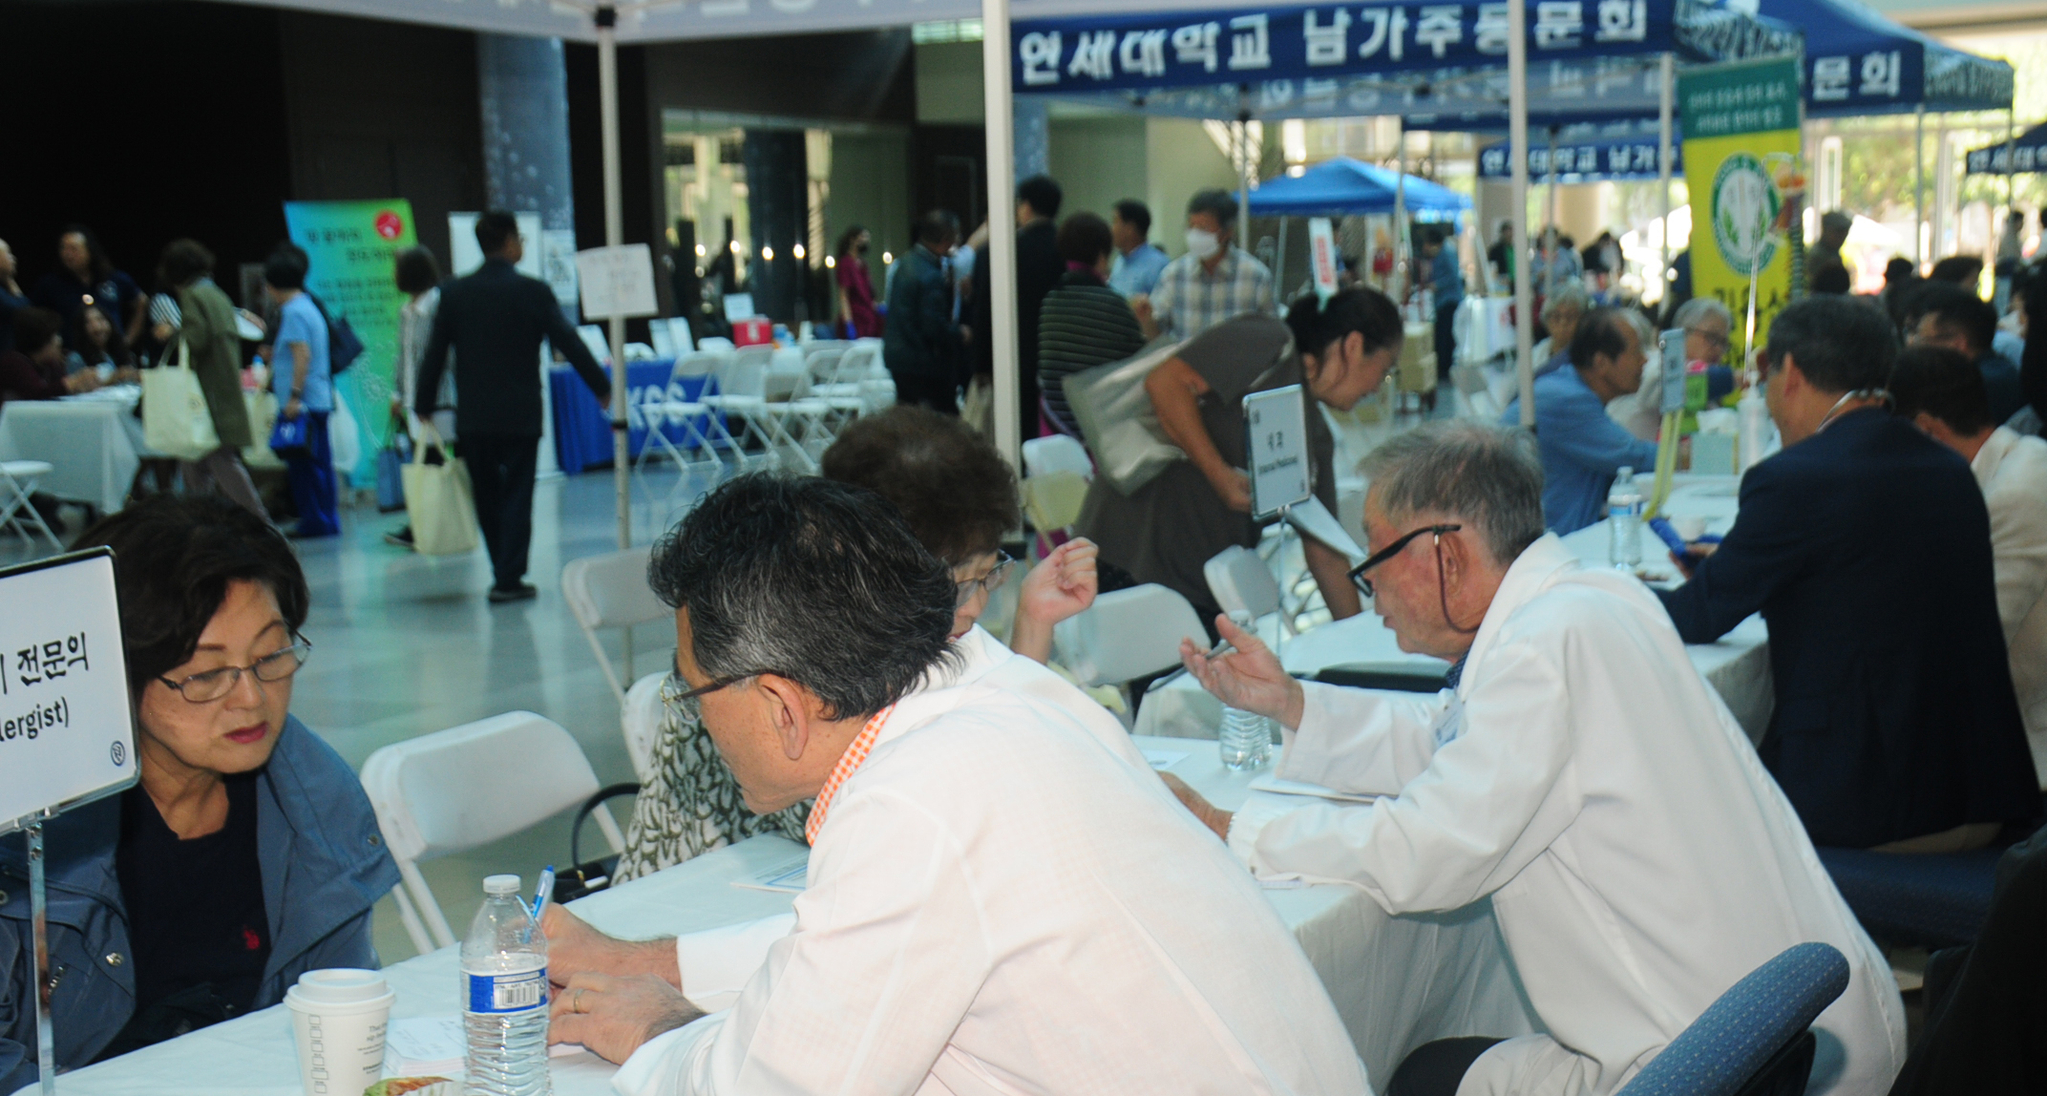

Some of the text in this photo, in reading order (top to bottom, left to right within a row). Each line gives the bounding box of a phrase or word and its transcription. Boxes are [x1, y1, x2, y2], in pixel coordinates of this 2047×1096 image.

[1019, 12, 1271, 86] 연세대학교
[1303, 0, 1647, 66] 남가주동문회
[1812, 51, 1901, 101] 문회
[17, 631, 89, 687] 전문의
